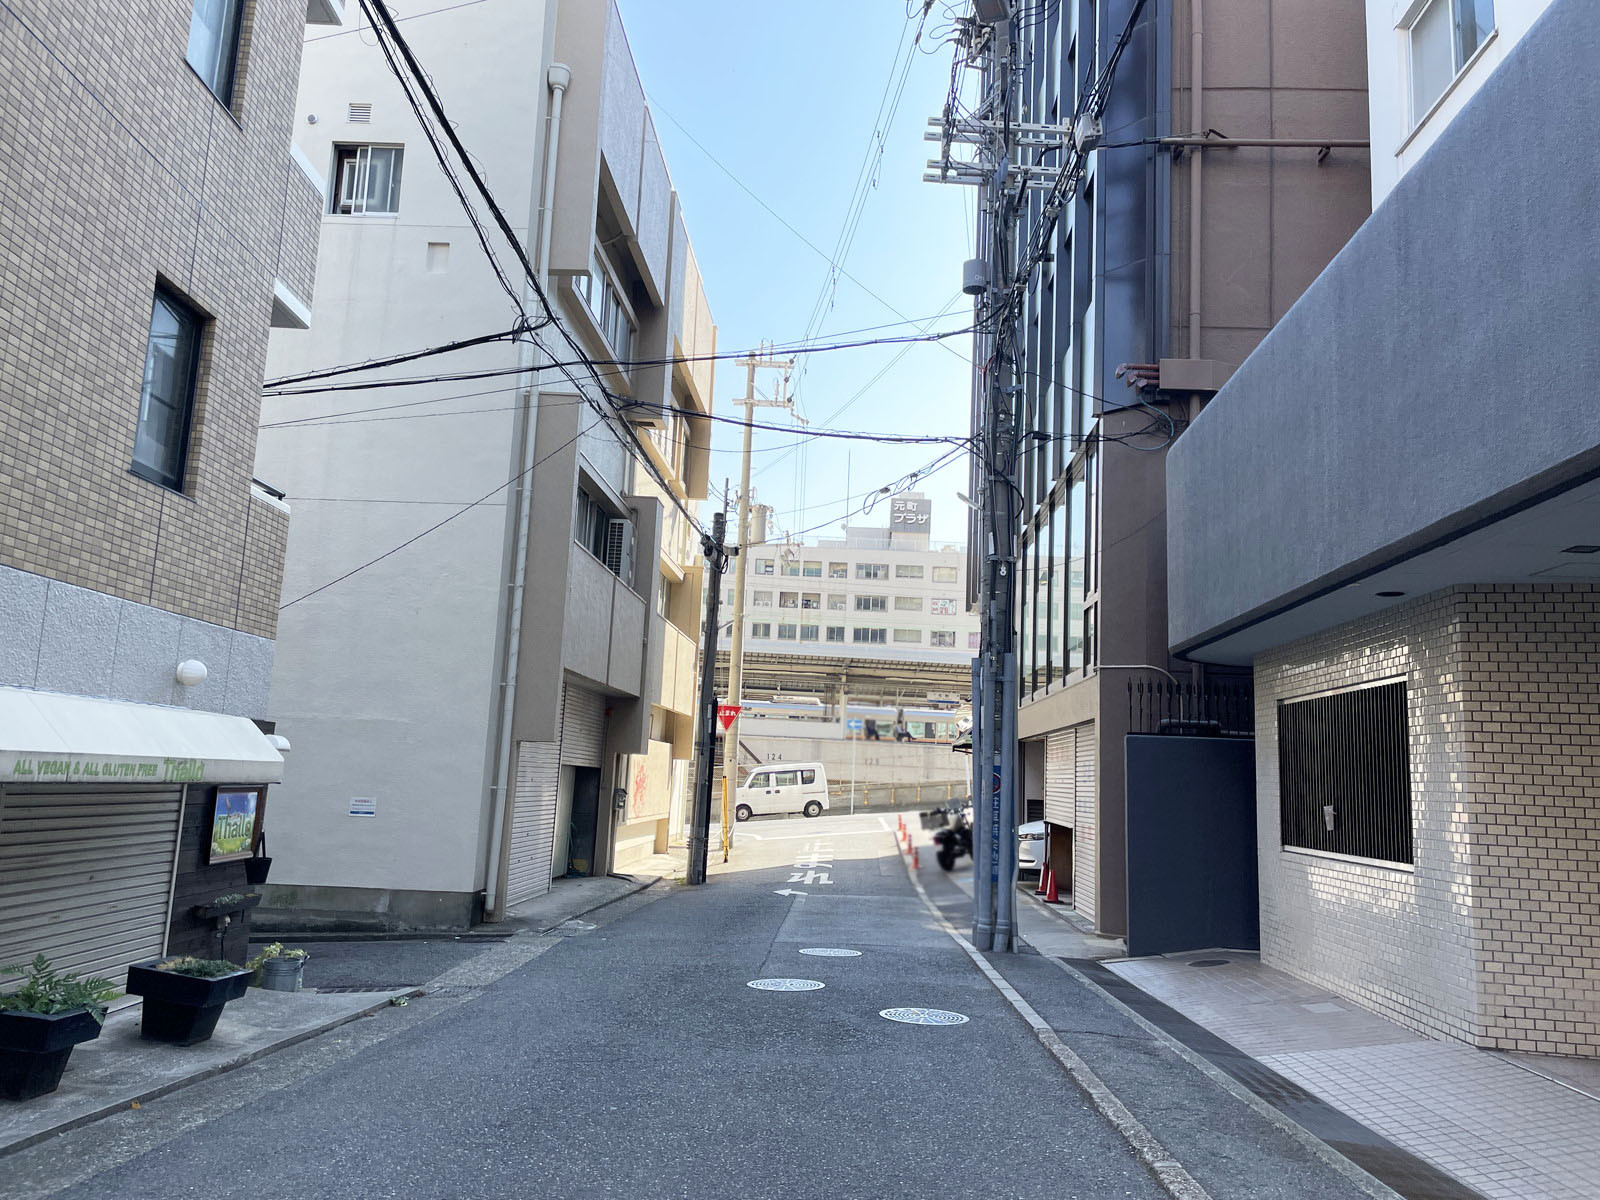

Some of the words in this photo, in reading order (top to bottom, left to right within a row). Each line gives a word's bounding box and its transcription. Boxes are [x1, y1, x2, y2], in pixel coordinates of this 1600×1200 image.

[894, 501, 917, 512] 元町
[894, 512, 929, 524] プラザ
[719, 709, 737, 717] 止まれ
[13, 758, 33, 775] ALL
[37, 760, 71, 776] VEGAN
[73, 761, 80, 775] &
[83, 761, 100, 776] ALL
[102, 763, 136, 777] GLUTEN
[137, 763, 158, 777] FREE
[218, 814, 252, 840] Thallo
